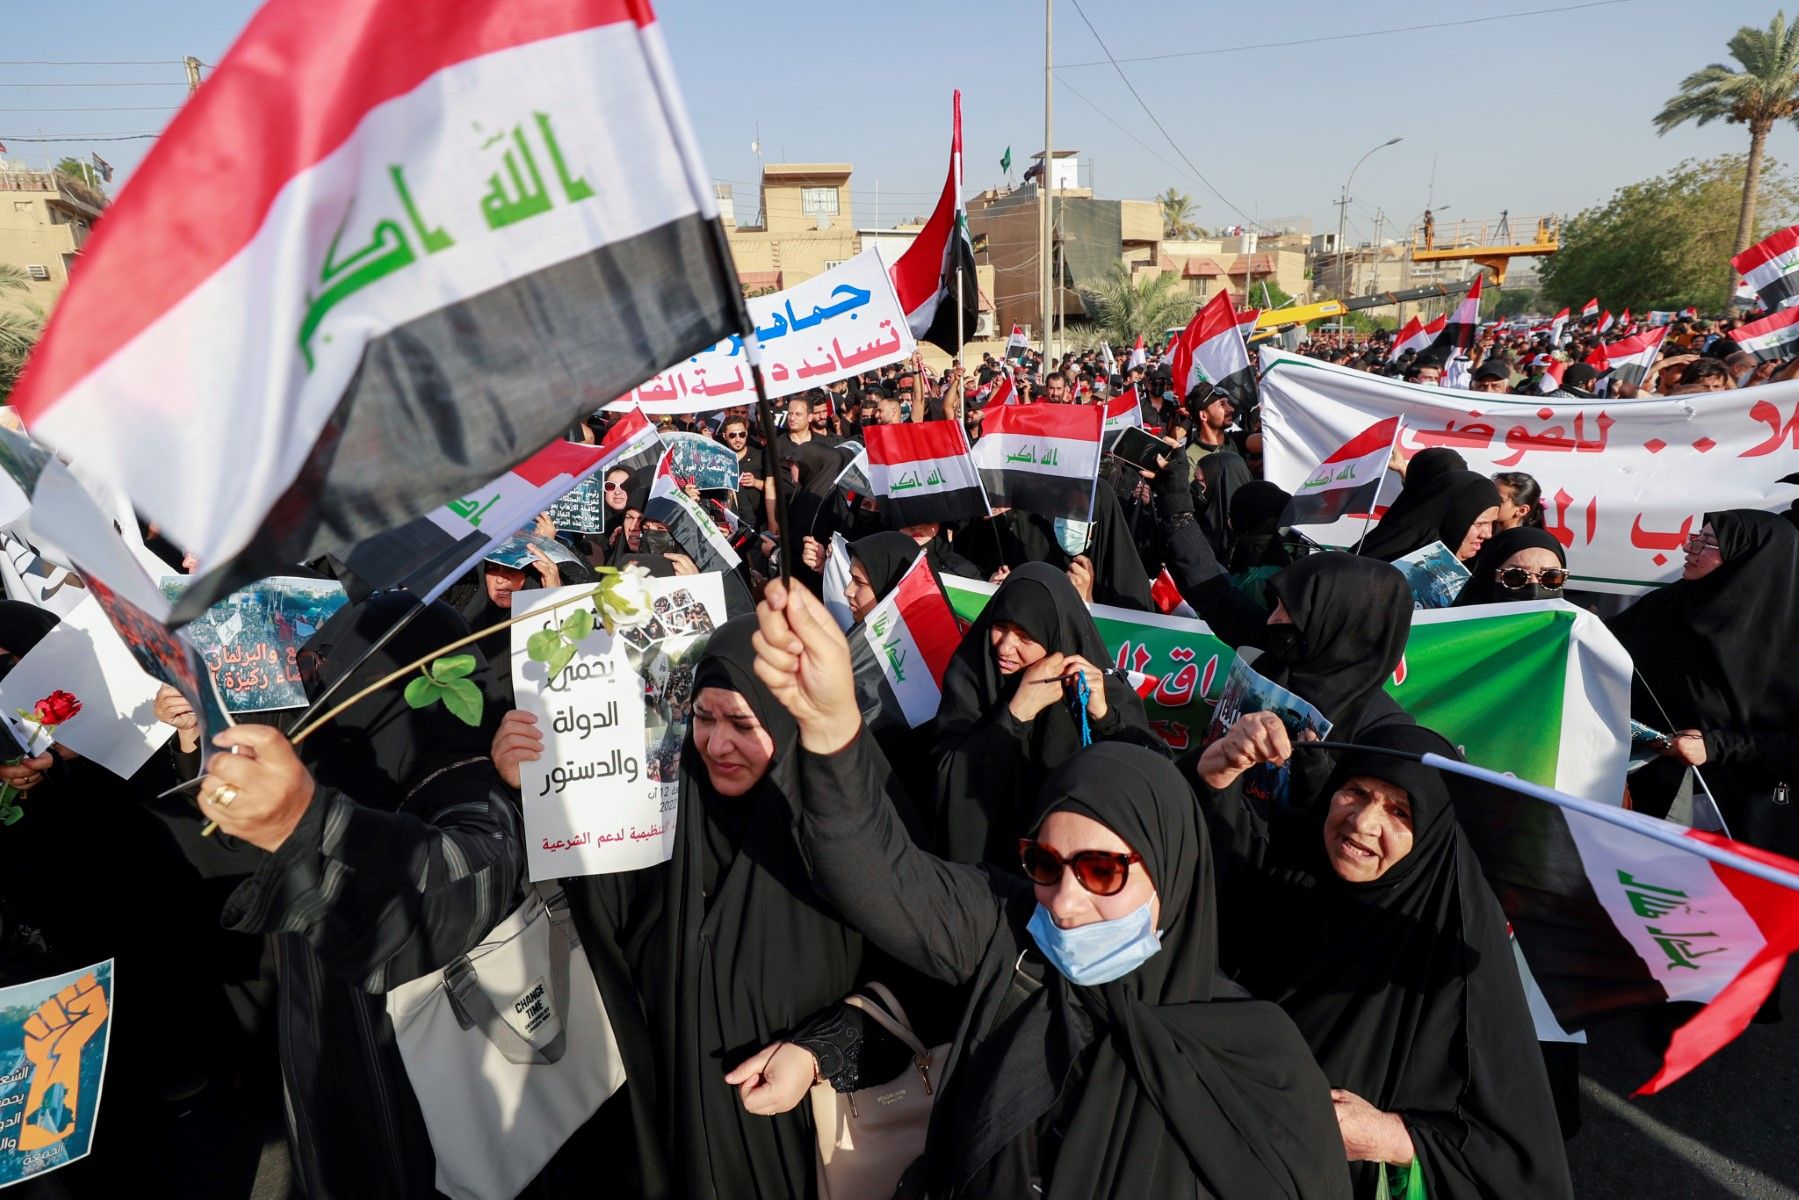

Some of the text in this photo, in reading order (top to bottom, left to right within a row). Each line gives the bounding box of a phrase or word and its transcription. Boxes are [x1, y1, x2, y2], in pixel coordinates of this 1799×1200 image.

[796, 319, 901, 379] تساند
[552, 701, 618, 740] الدولة
[539, 749, 639, 797] والدستور
[542, 832, 591, 852] الشرعية
[515, 984, 545, 1014] CHANGE
[525, 999, 544, 1019] TIME
[0, 1066, 29, 1086] الشع
